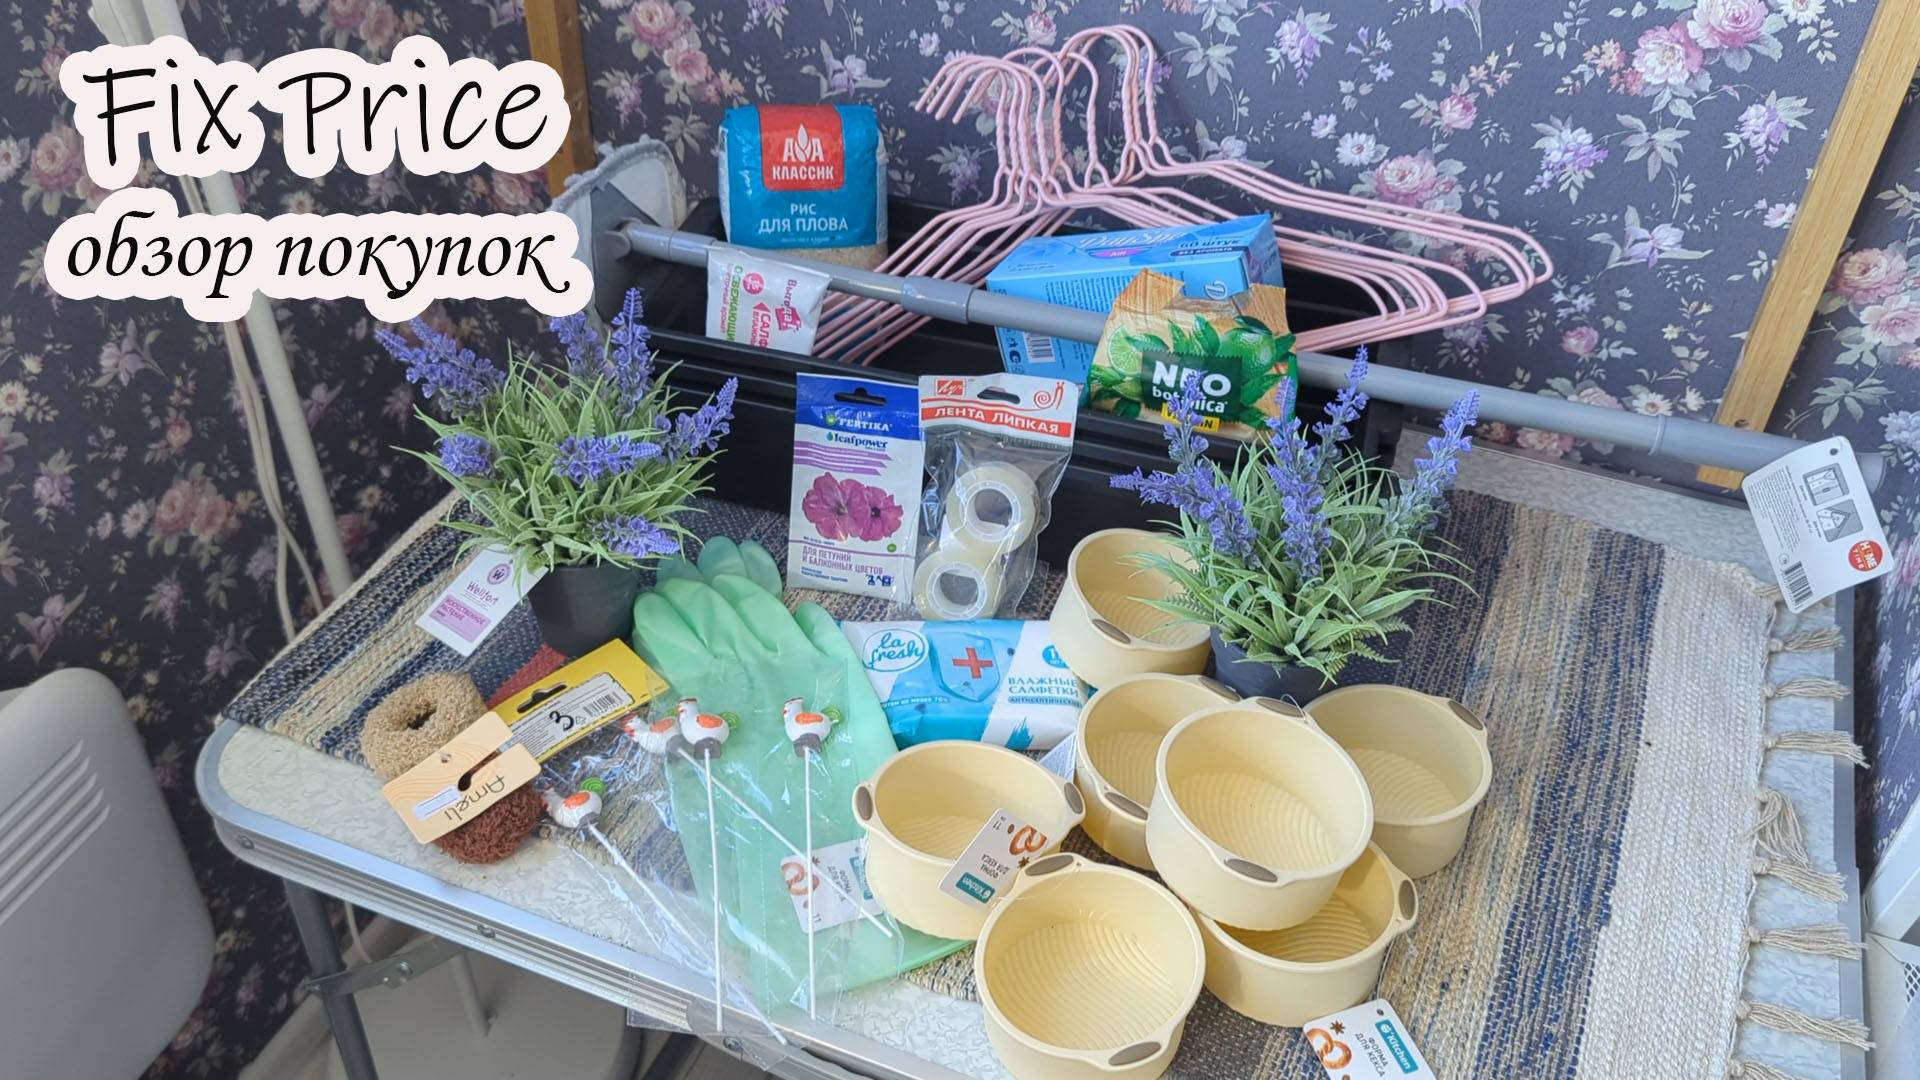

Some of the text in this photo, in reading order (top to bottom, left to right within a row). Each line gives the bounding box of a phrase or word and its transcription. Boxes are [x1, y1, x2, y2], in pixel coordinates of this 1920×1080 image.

[772, 165, 834, 180] КЛАССИК
[790, 203, 817, 216] РИС
[758, 217, 849, 235] ДЛЯ ПЛОВА
[934, 407, 1059, 434] ЛЕНТА ЛИПКАЯ
[879, 632, 906, 648] la
[868, 640, 921, 670] fresh
[1008, 677, 1078, 688] ВЛАЖНЫЕ
[1008, 685, 1079, 698] САЛФЕТКИ
[444, 774, 505, 820] Ameli
[1355, 1033, 1386, 1077] ДЛЯ КЕКСА
[1368, 1037, 1389, 1067] ФОРМА
